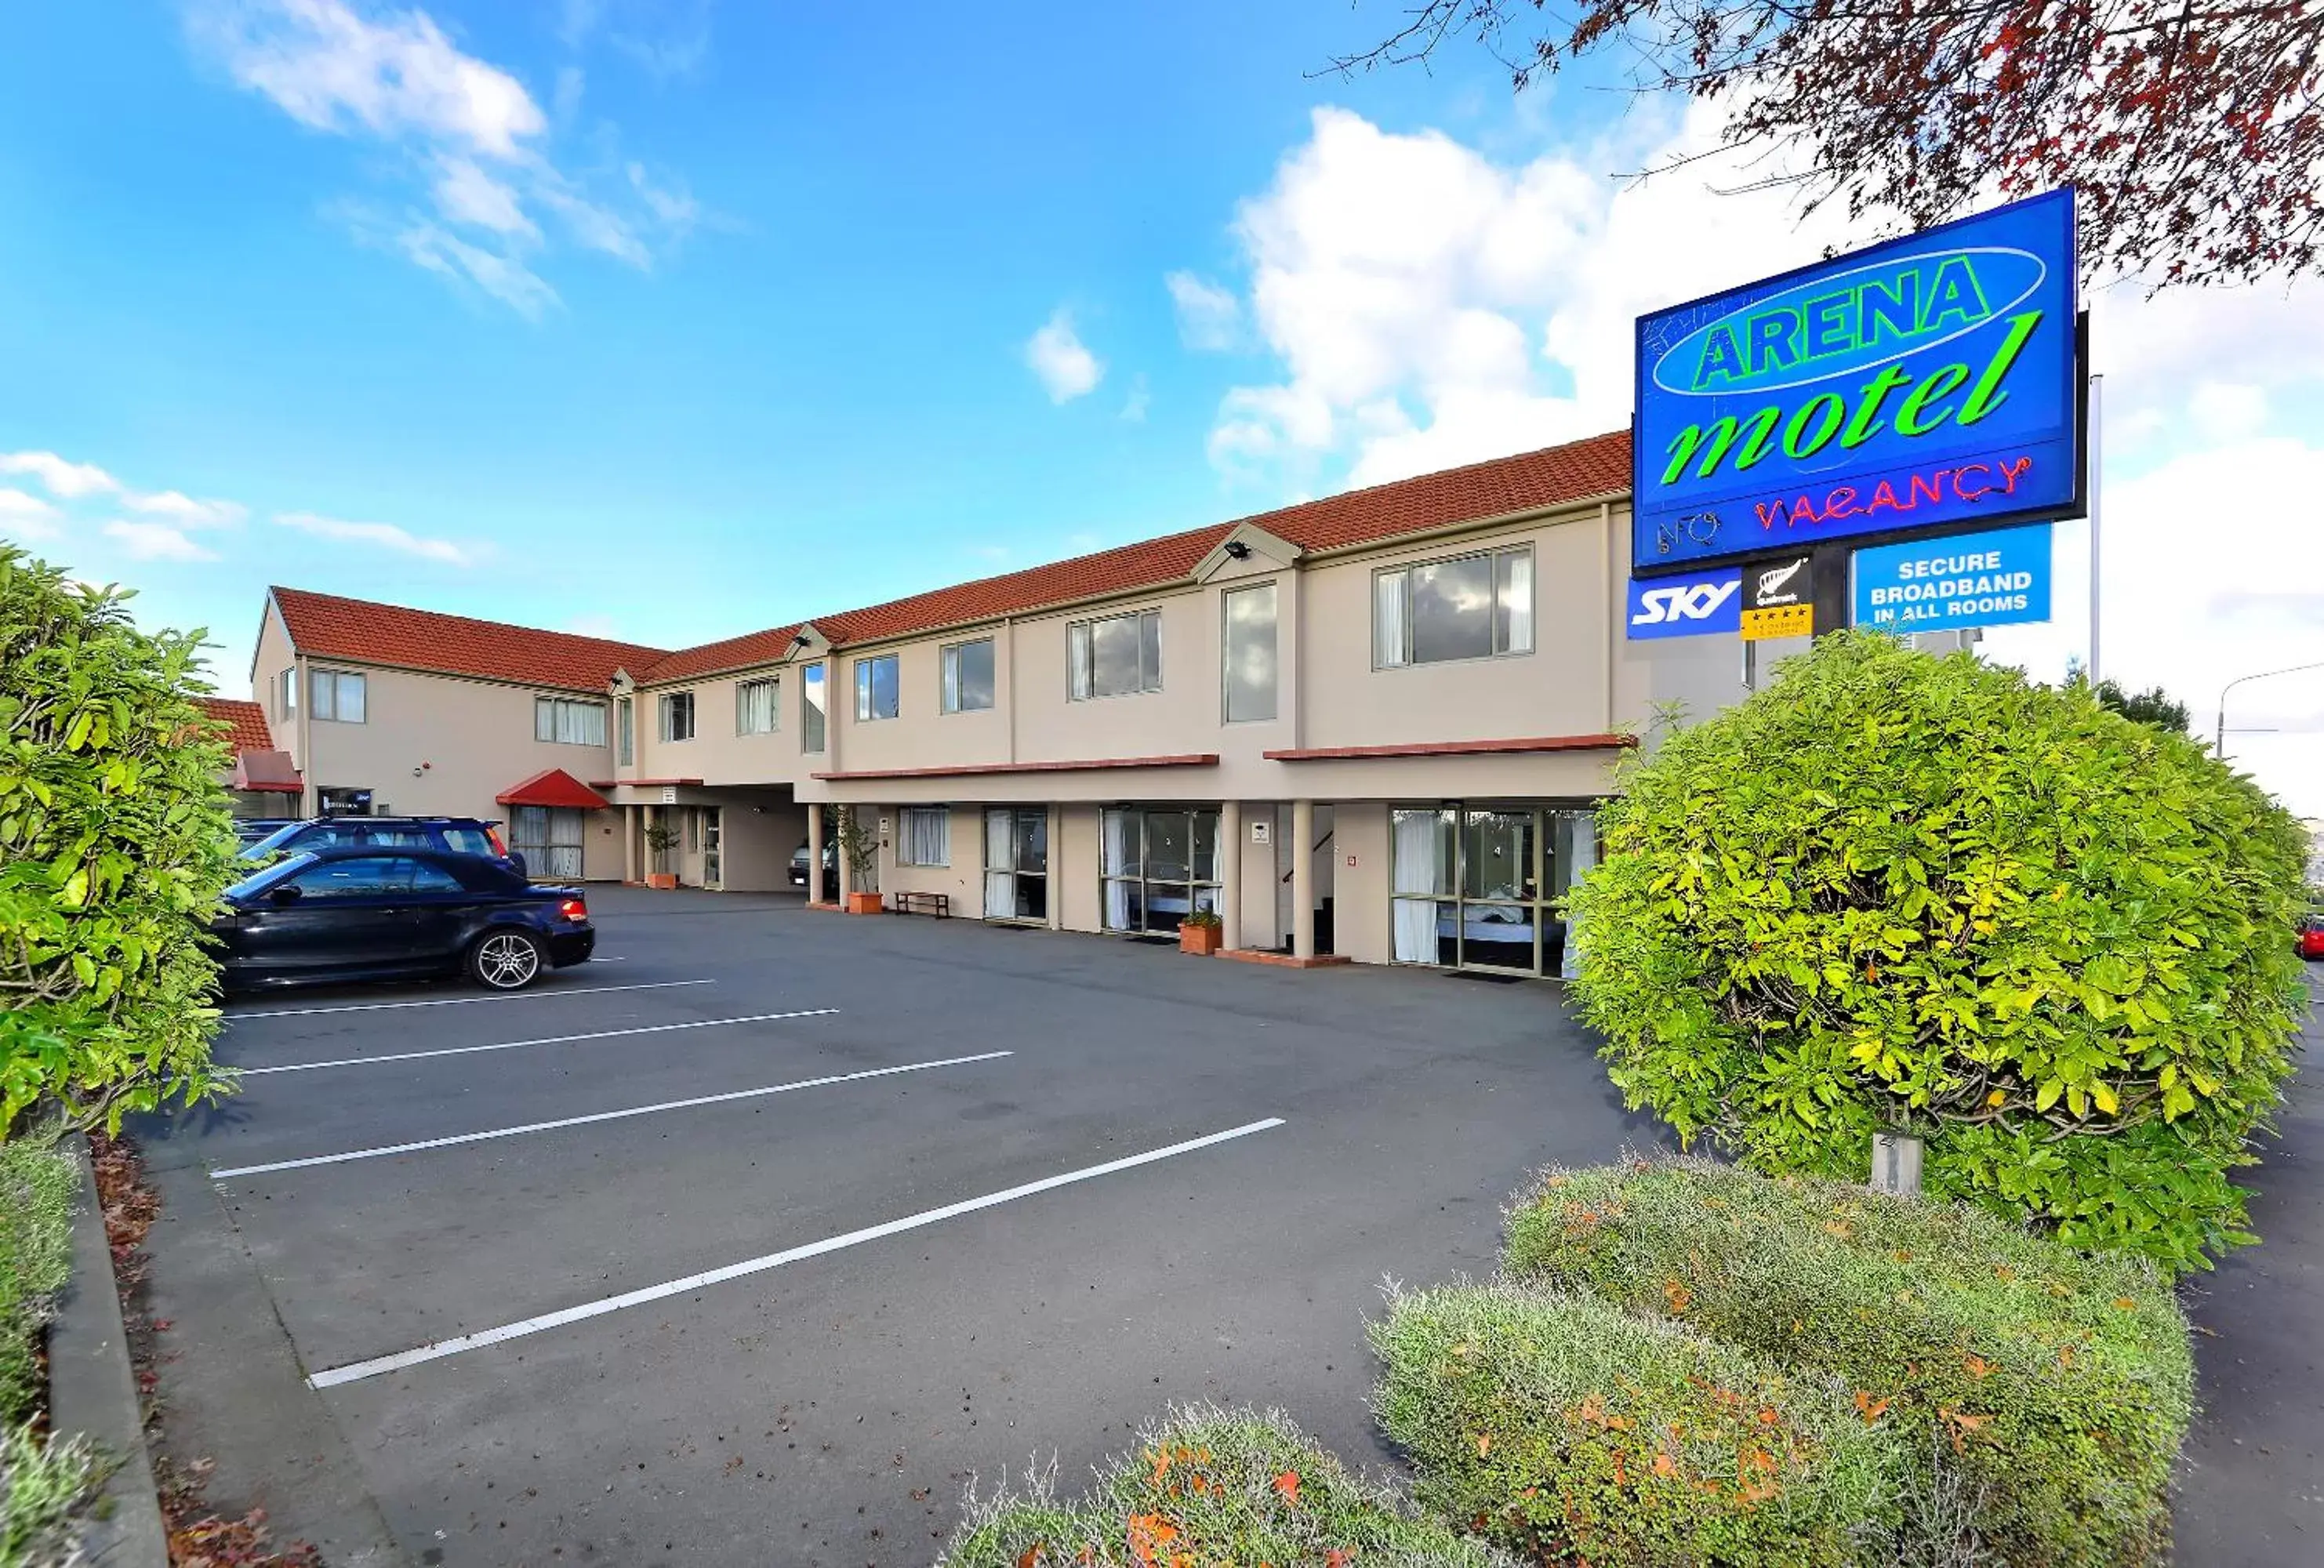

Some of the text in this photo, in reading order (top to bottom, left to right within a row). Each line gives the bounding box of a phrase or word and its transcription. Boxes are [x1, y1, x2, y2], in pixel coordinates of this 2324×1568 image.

[1690, 253, 1992, 392] ARENA
[1661, 309, 2045, 486] motel
[1658, 456, 2032, 554] NO VACANCY
[1870, 571, 2032, 606] BROADBAND
[1898, 551, 2002, 580] SECURE
[1631, 579, 1742, 626] SKY
[1873, 593, 2028, 624] IN ALL ROOMS
